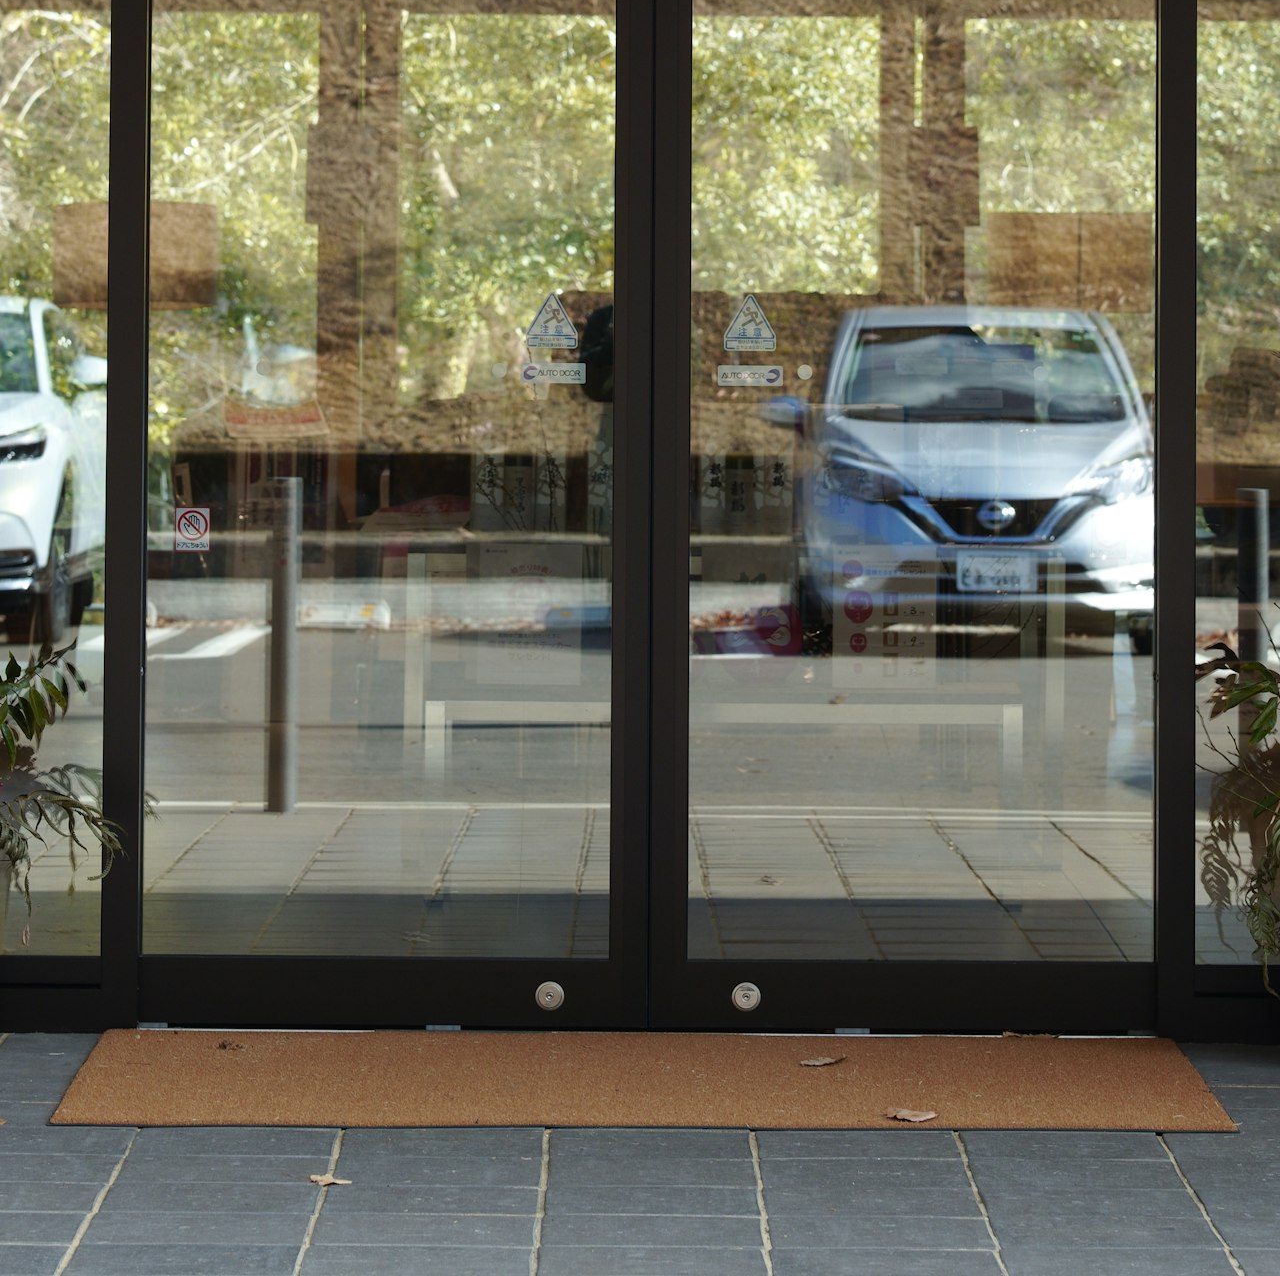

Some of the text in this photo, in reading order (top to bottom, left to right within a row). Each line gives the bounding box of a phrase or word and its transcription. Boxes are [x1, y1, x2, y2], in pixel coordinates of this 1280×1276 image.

[540, 324, 564, 334] 注意
[738, 327, 763, 336] 注意
[537, 369, 582, 378] AUTO DOOR
[721, 372, 742, 380] AUTO
